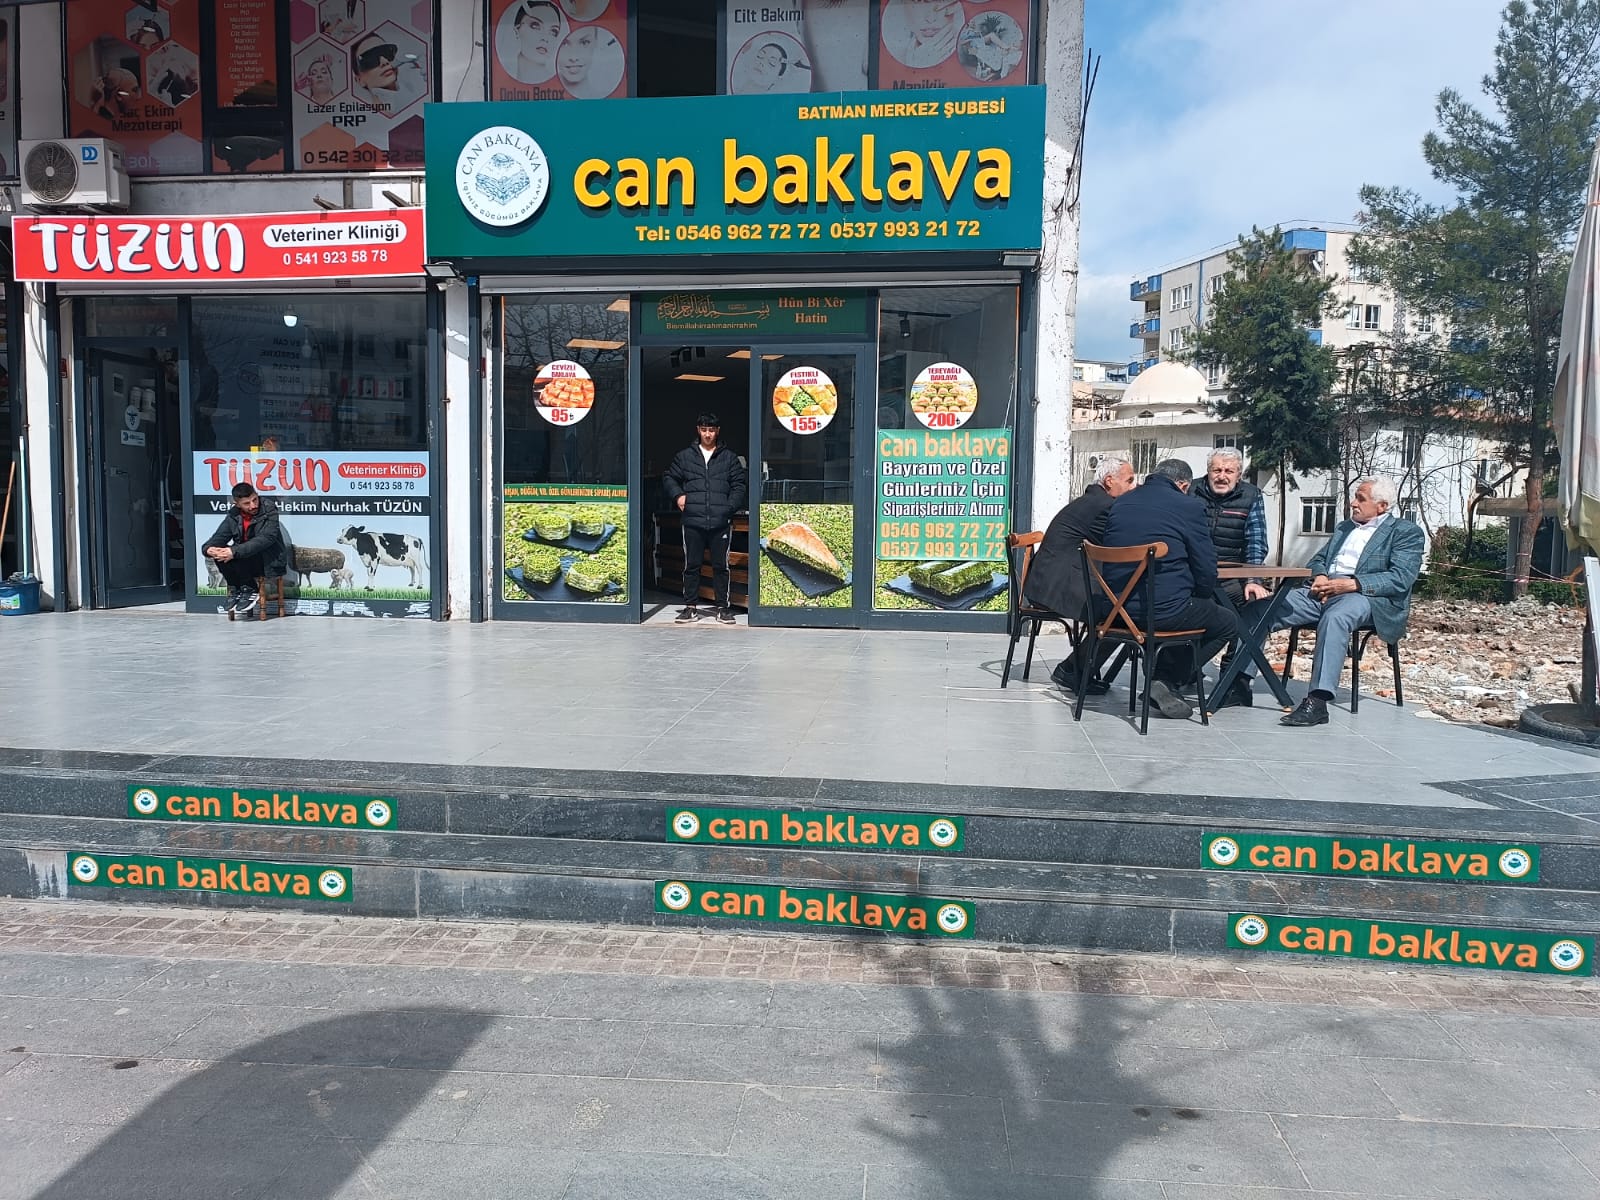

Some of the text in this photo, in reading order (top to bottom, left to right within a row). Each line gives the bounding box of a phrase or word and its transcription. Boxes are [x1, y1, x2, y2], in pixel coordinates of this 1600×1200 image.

[735, 8, 804, 23] Cilt Bakımı
[144, 104, 174, 118] Ekim
[308, 102, 391, 114] Lazer Epilasyon
[798, 97, 1005, 120] BATMAN MERKEZ ŞUBESİ
[112, 118, 182, 132] Mezoterapi
[332, 115, 366, 127] PRP
[304, 152, 314, 164] 0
[318, 150, 348, 163] 542
[352, 150, 376, 162] 301
[462, 133, 542, 175] CAN BAKLAVA
[573, 133, 1012, 208] can baklava
[271, 222, 400, 244] Veteriner Kliniği
[635, 220, 980, 241] Tel: 0546 962 72 72 0537 993 21 72
[282, 250, 388, 266] 0 541 923 58 78
[778, 296, 846, 308] Hûn Bi Xêr
[795, 312, 828, 324] Hatin
[880, 432, 1008, 457] can baklava
[343, 464, 422, 478] Veteriner Kliniği
[882, 458, 1006, 478] Bayram ve Özel
[350, 482, 414, 490] 0 541 923 58 78
[882, 480, 1006, 498] Günleriniz İçin
[275, 499, 422, 513] Hekim Nurhak TÜZÜN
[883, 502, 1004, 518] Siparişleriniz Alınır
[880, 522, 1005, 538] 0546 962 72 72
[880, 541, 1005, 558] 0537 993 21 72
[165, 795, 222, 816] can
[232, 792, 358, 824] baklava
[709, 818, 769, 840] can
[782, 814, 920, 846] baklava
[1249, 841, 1490, 877] can baklava
[107, 863, 165, 886] can
[176, 860, 310, 896] baklava
[700, 890, 765, 916] can
[779, 890, 928, 930] baklava
[1279, 924, 1538, 968] can baklava
